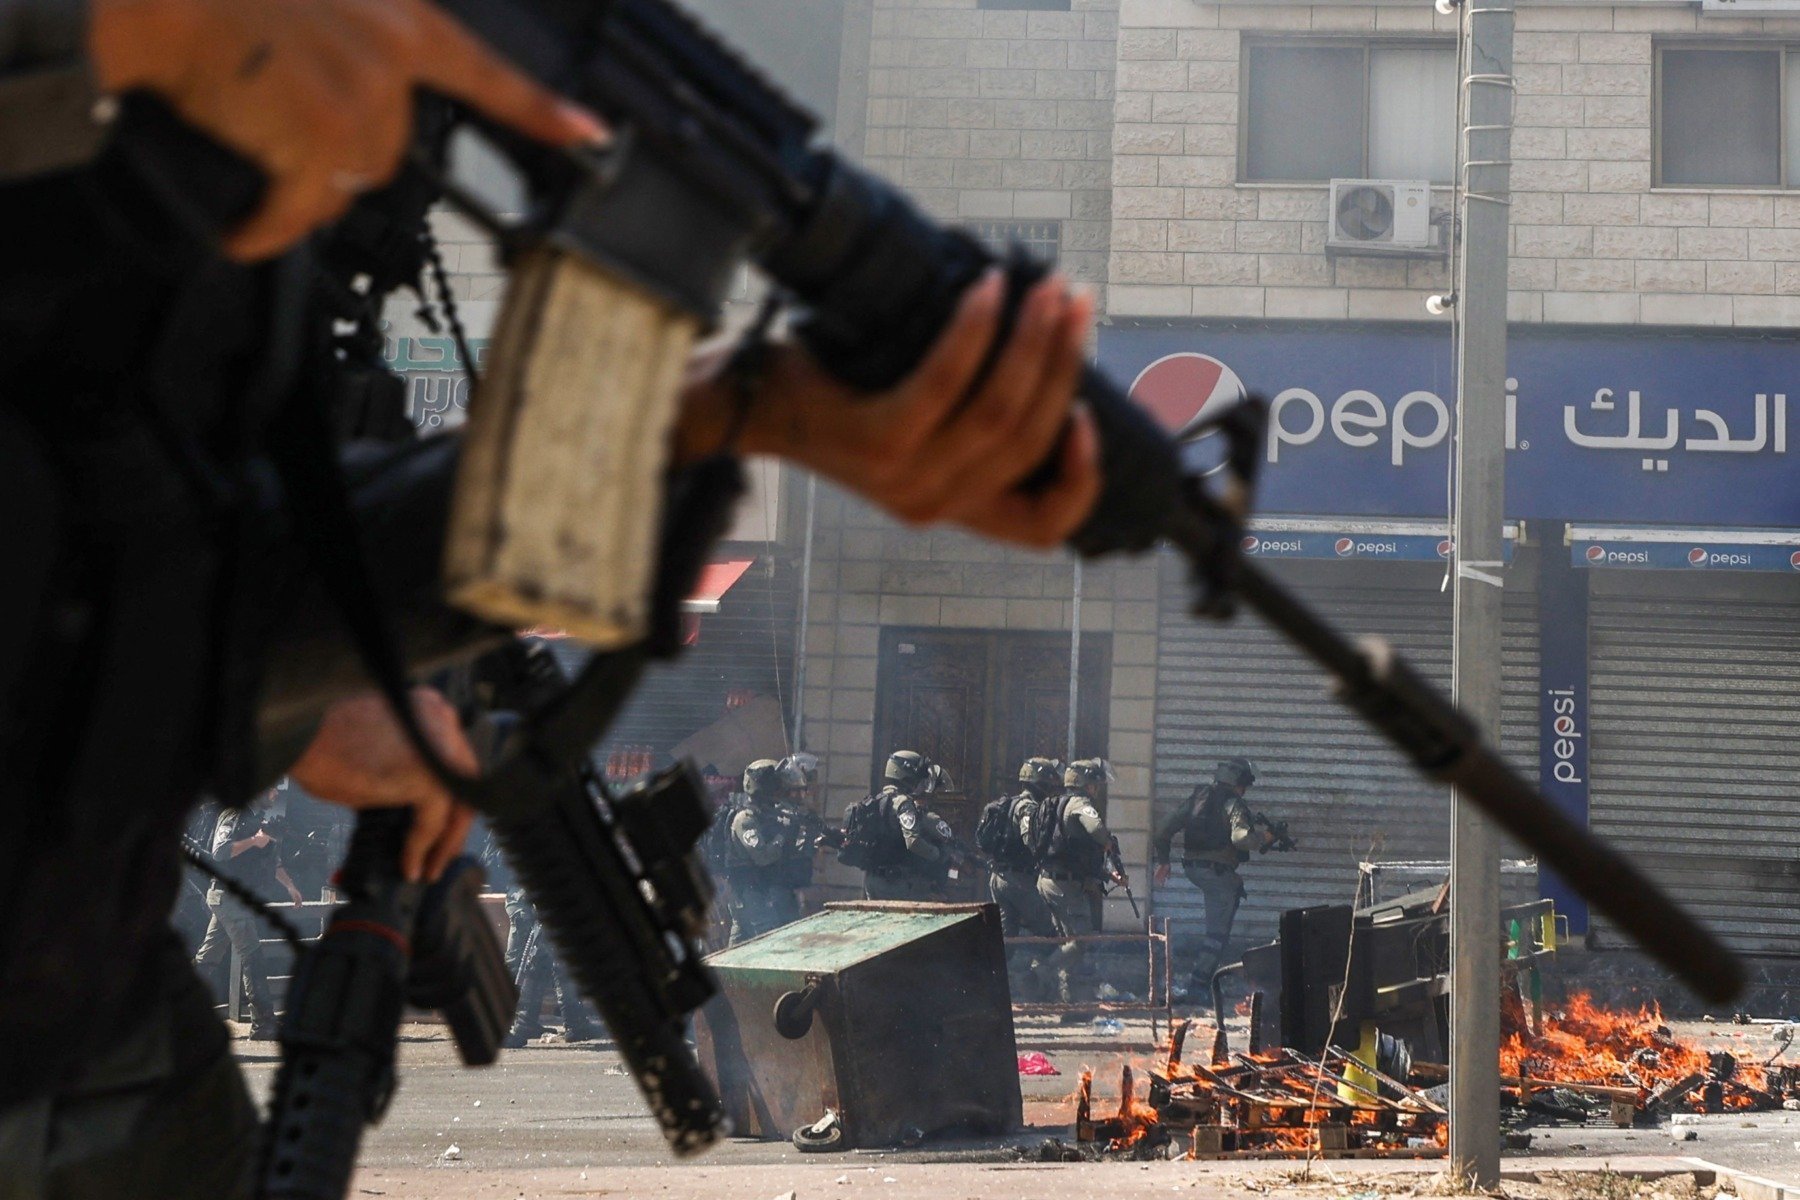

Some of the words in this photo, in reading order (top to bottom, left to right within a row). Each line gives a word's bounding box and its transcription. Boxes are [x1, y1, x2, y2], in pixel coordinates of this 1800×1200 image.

[1267, 376, 1519, 466] pepi
[1564, 387, 1786, 472] الديك
[1261, 539, 1302, 553] pepsi
[1356, 541, 1397, 555] pepsi
[1608, 550, 1649, 564] pepsi
[1710, 552, 1751, 566] pepsi
[1548, 689, 1582, 783] pepsi
